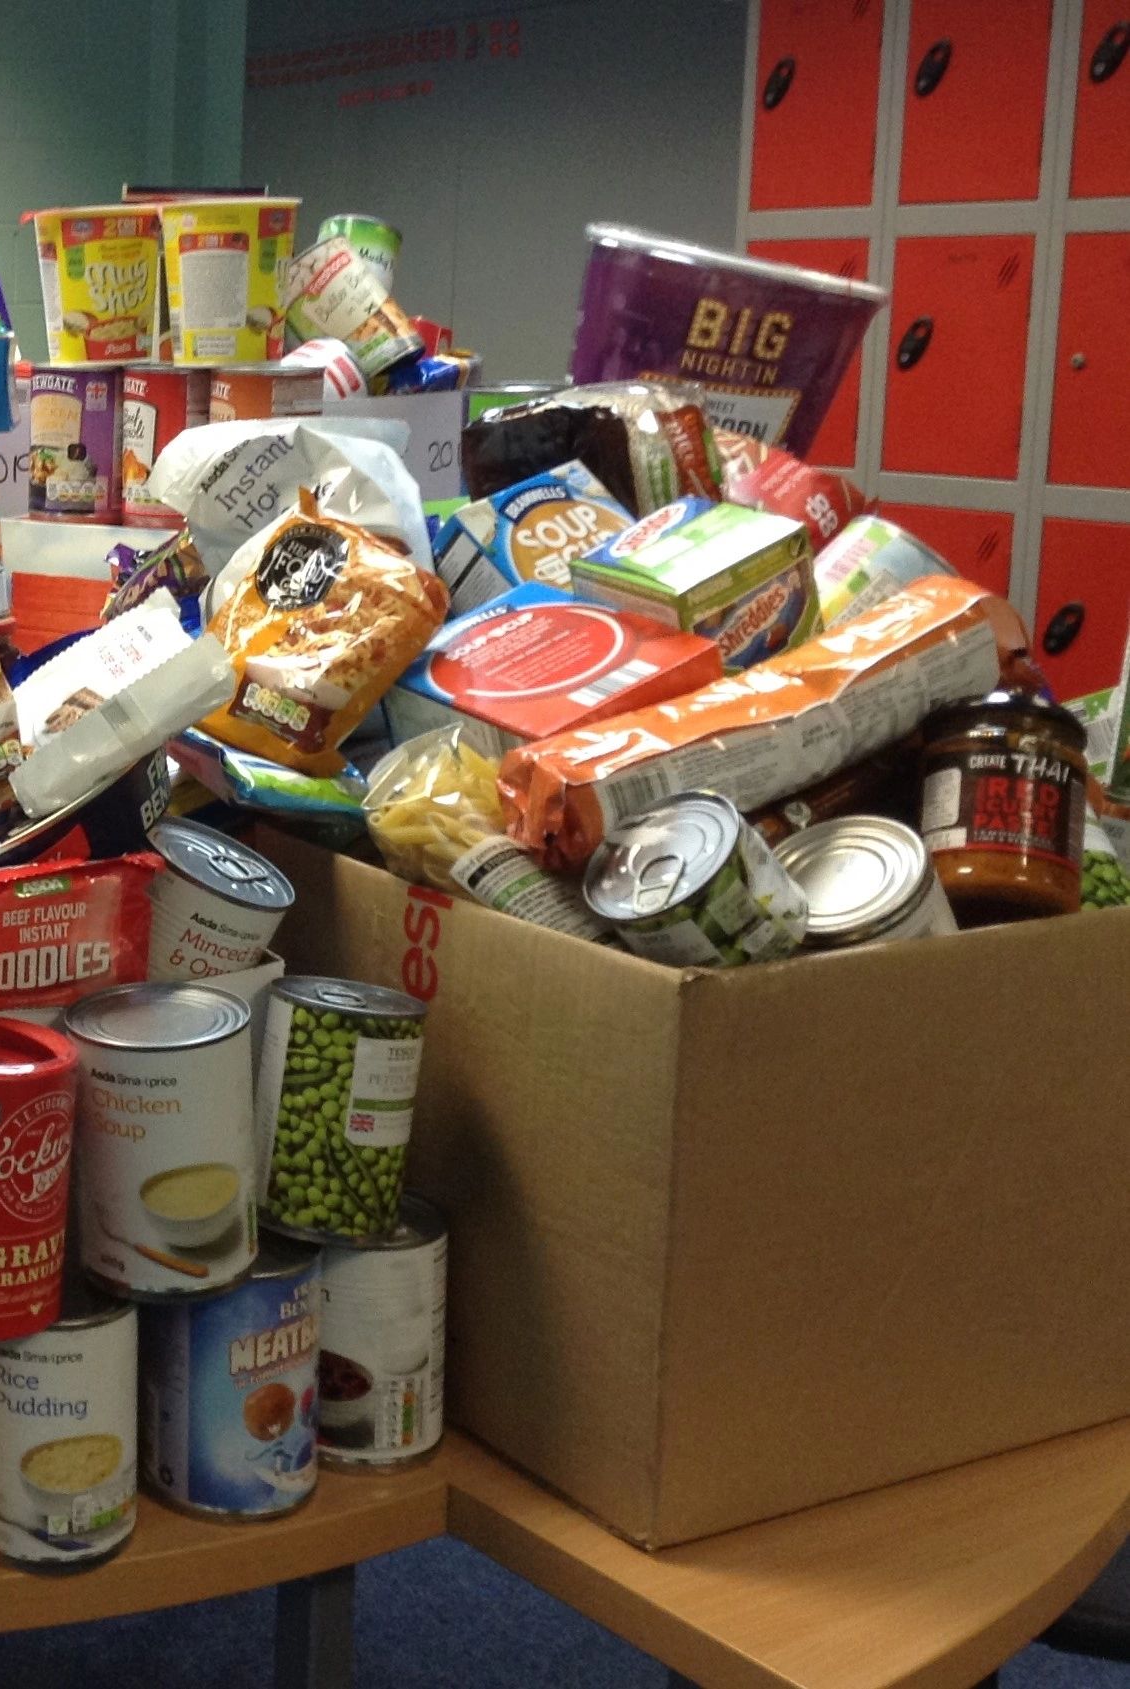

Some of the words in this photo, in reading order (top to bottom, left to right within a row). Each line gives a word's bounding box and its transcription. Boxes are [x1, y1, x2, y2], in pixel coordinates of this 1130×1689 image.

[686, 298, 792, 362] BIG
[681, 351, 751, 381] NIGHT
[752, 364, 780, 385] IN
[214, 432, 295, 511] Instant
[234, 480, 284, 531] Hot
[515, 504, 599, 550] SOUP
[719, 584, 788, 657] Shreddies
[1010, 753, 1070, 783] THAI
[2, 908, 30, 927] BEEF
[33, 902, 87, 922] FLAVOUR
[189, 912, 217, 930] Asda
[18, 924, 70, 943] INSTANT
[179, 927, 254, 963] Minced
[90, 1067, 117, 1084] Asda
[91, 1086, 183, 1116] Chicken
[91, 1115, 147, 1142] Soup
[229, 1315, 319, 1375] MEATB
